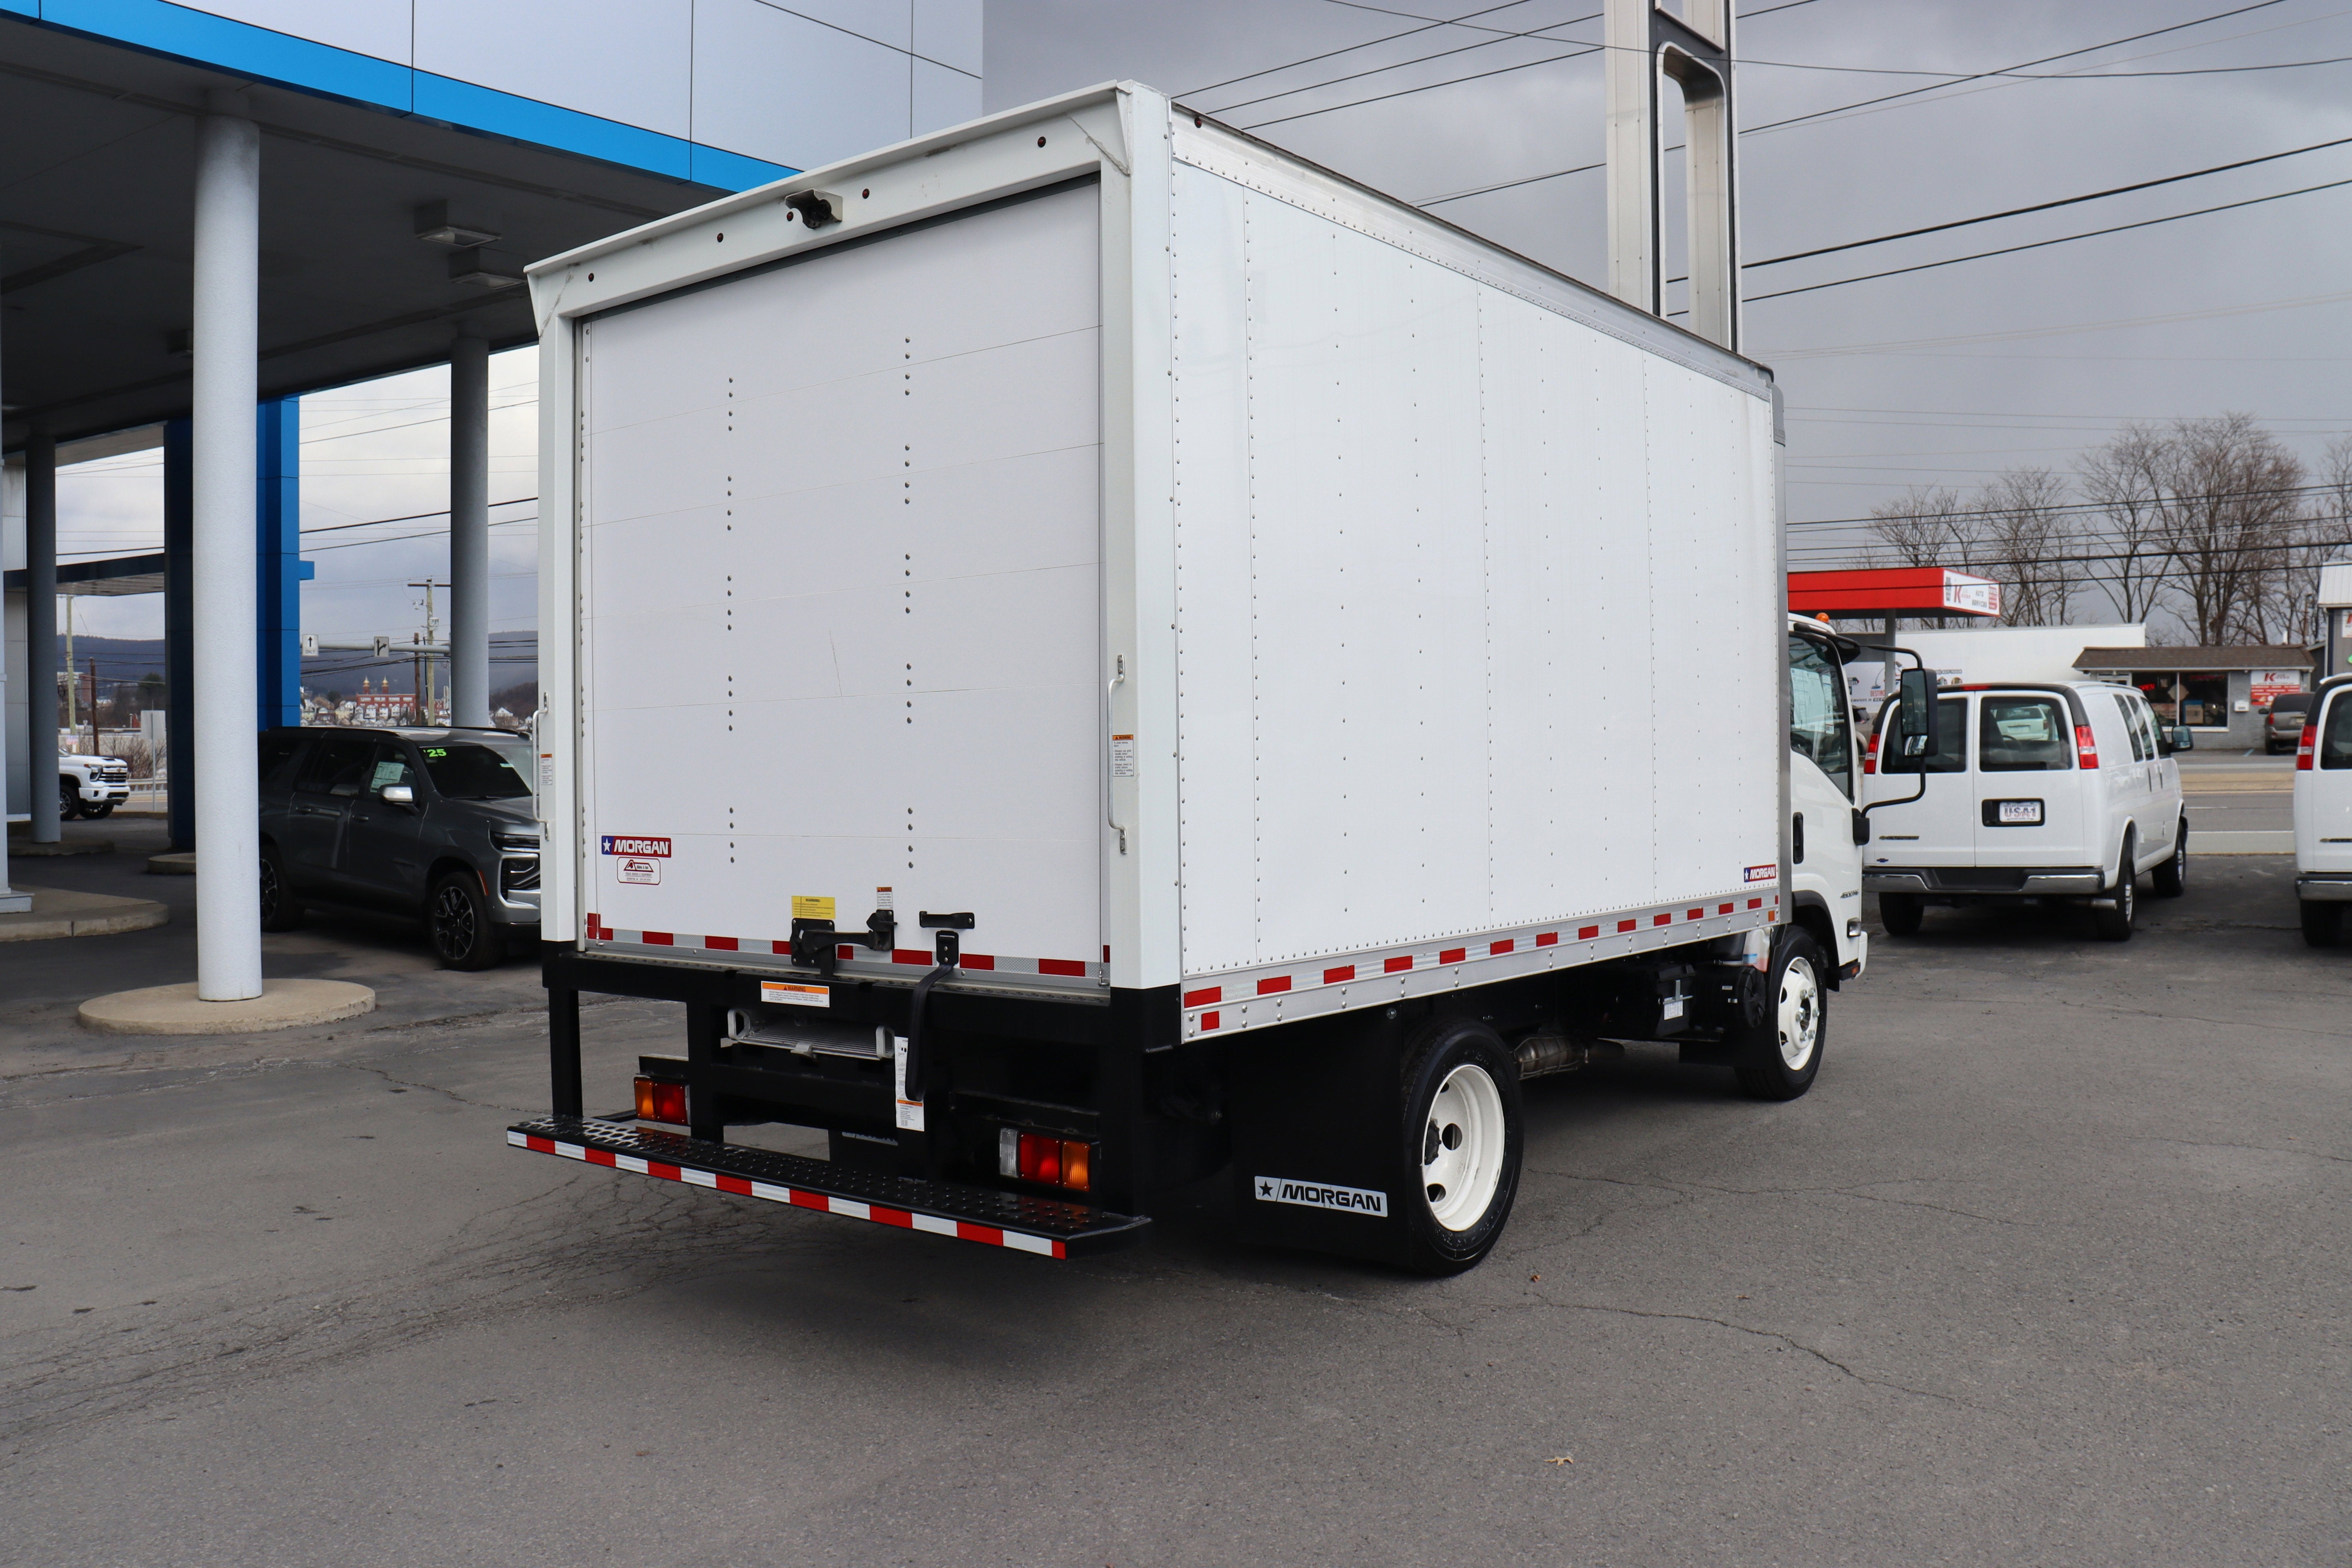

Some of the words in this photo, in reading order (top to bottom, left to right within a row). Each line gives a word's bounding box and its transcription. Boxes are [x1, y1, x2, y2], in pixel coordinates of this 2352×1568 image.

[423, 749, 447, 757] '25
[614, 839, 668, 855] MORGAN
[1750, 866, 1775, 880] MORGAN
[1282, 1184, 1381, 1212] MORGAN
